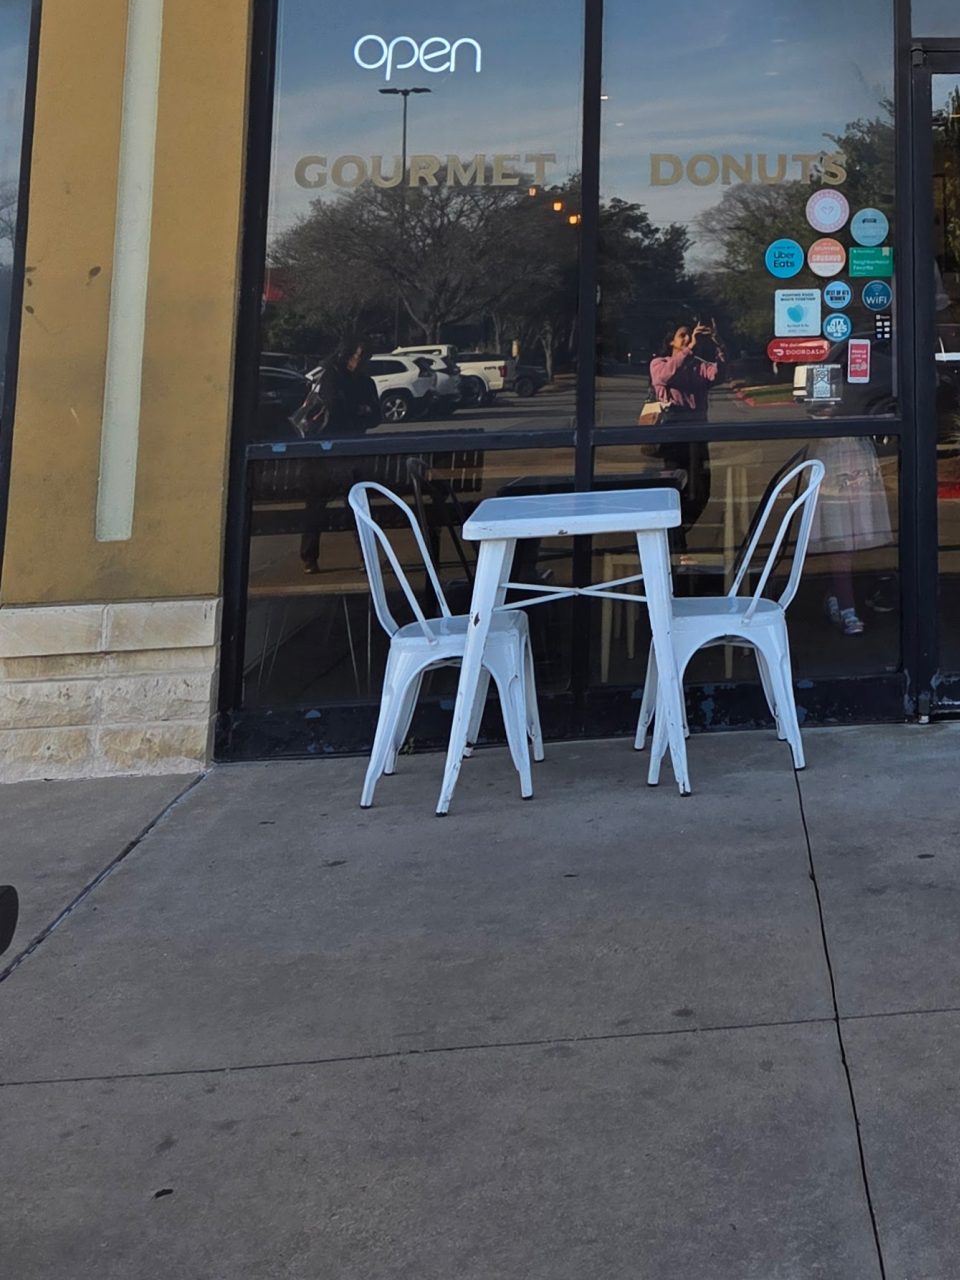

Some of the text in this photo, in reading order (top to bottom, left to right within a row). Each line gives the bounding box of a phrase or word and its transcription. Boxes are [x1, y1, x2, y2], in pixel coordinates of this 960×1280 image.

[353, 34, 482, 81] open
[294, 151, 849, 189] GOURMET DONUTS
[773, 250, 796, 259] Uber
[773, 259, 796, 269] Eats
